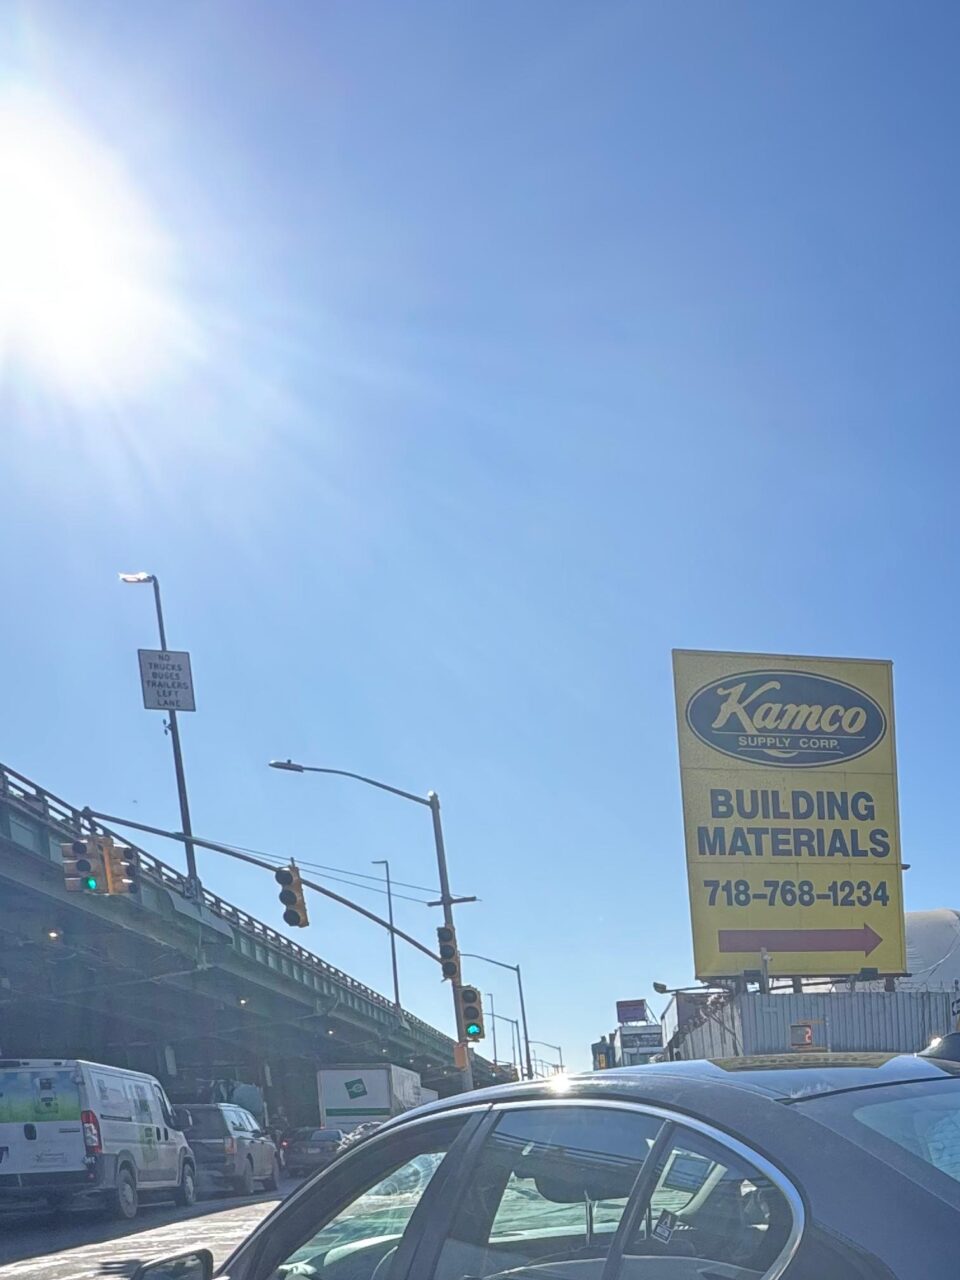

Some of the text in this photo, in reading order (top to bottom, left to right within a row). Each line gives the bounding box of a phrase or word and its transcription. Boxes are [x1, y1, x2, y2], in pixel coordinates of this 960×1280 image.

[148, 662, 182, 671] TRUCKS
[711, 680, 867, 735] Kamco
[738, 735, 791, 748] SUPPLY
[709, 788, 876, 821] BUILDING
[697, 826, 891, 858] MATERIALS
[703, 879, 890, 907] 718-768-1234
